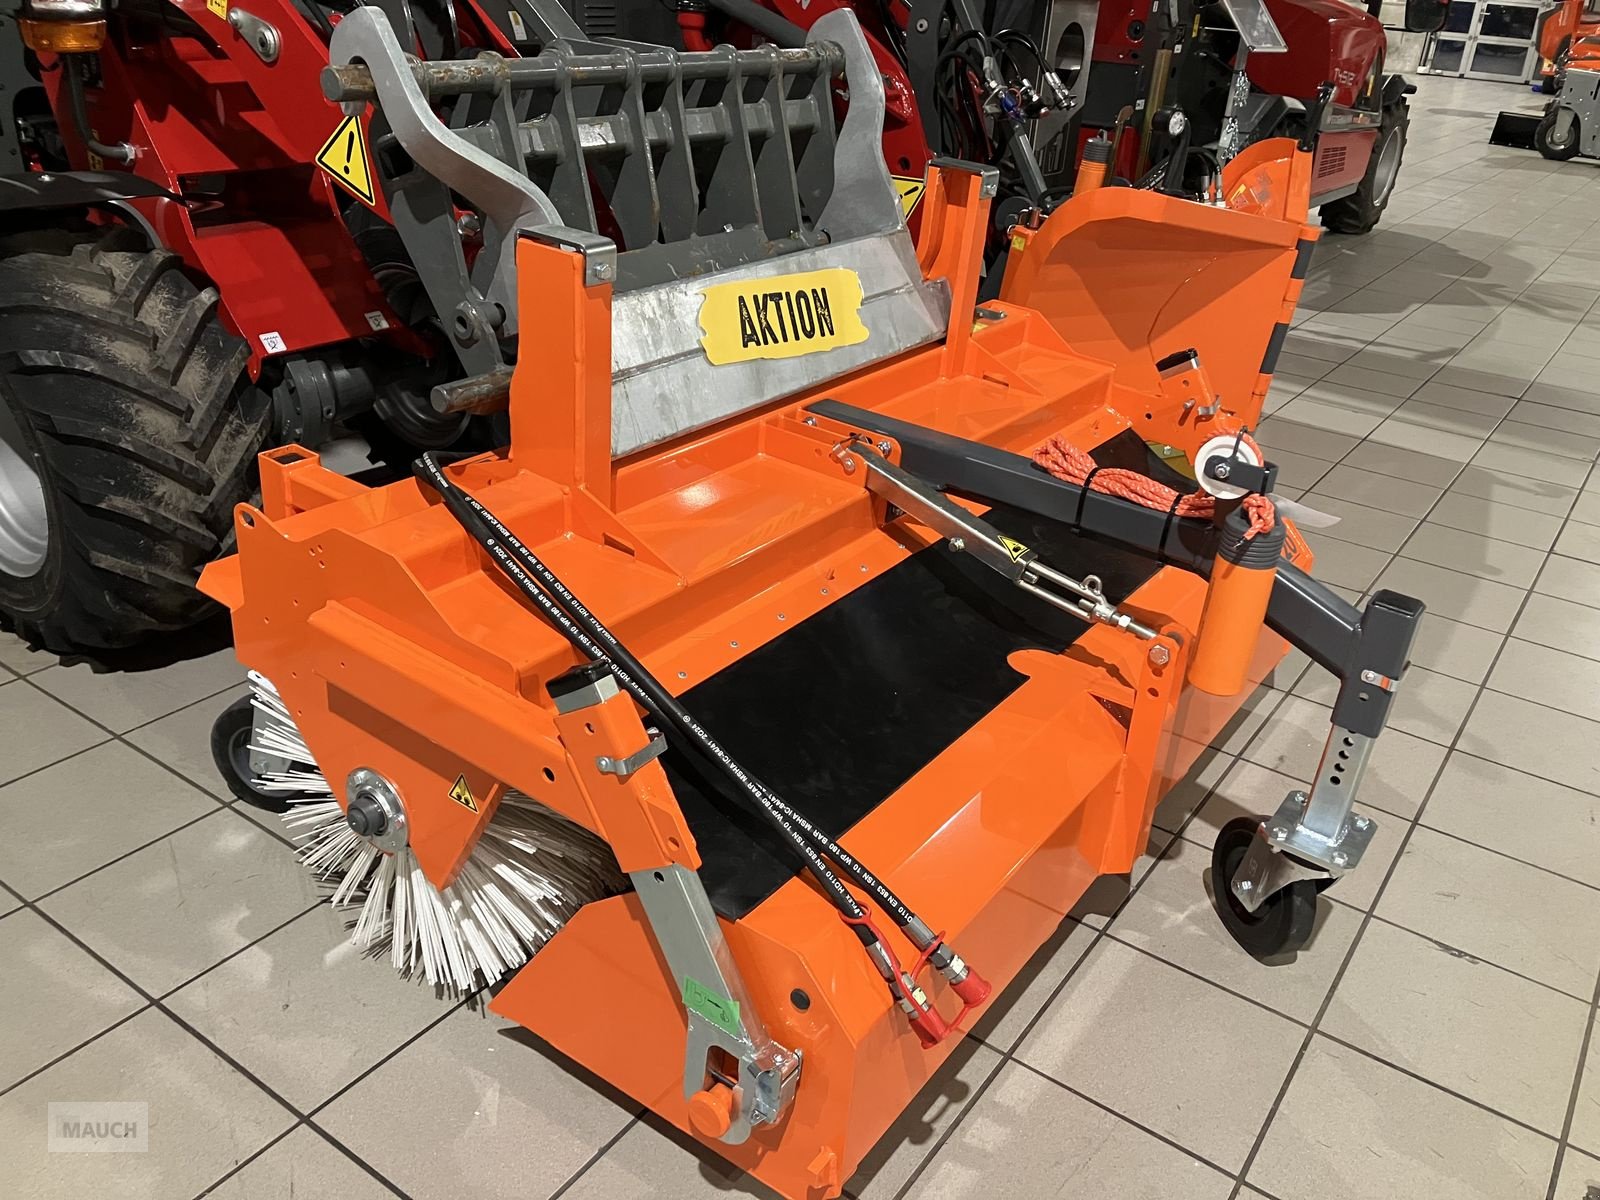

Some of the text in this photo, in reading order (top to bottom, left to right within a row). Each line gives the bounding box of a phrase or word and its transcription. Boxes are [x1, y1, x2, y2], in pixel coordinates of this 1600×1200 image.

[738, 287, 835, 348] AKTION
[524, 579, 541, 594] MSHA
[572, 600, 591, 617] HD110
[611, 664, 630, 682] HD110
[729, 762, 747, 782] MSHA
[793, 813, 812, 831] MSHA
[826, 871, 844, 894] HD110
[898, 907, 913, 923] D110
